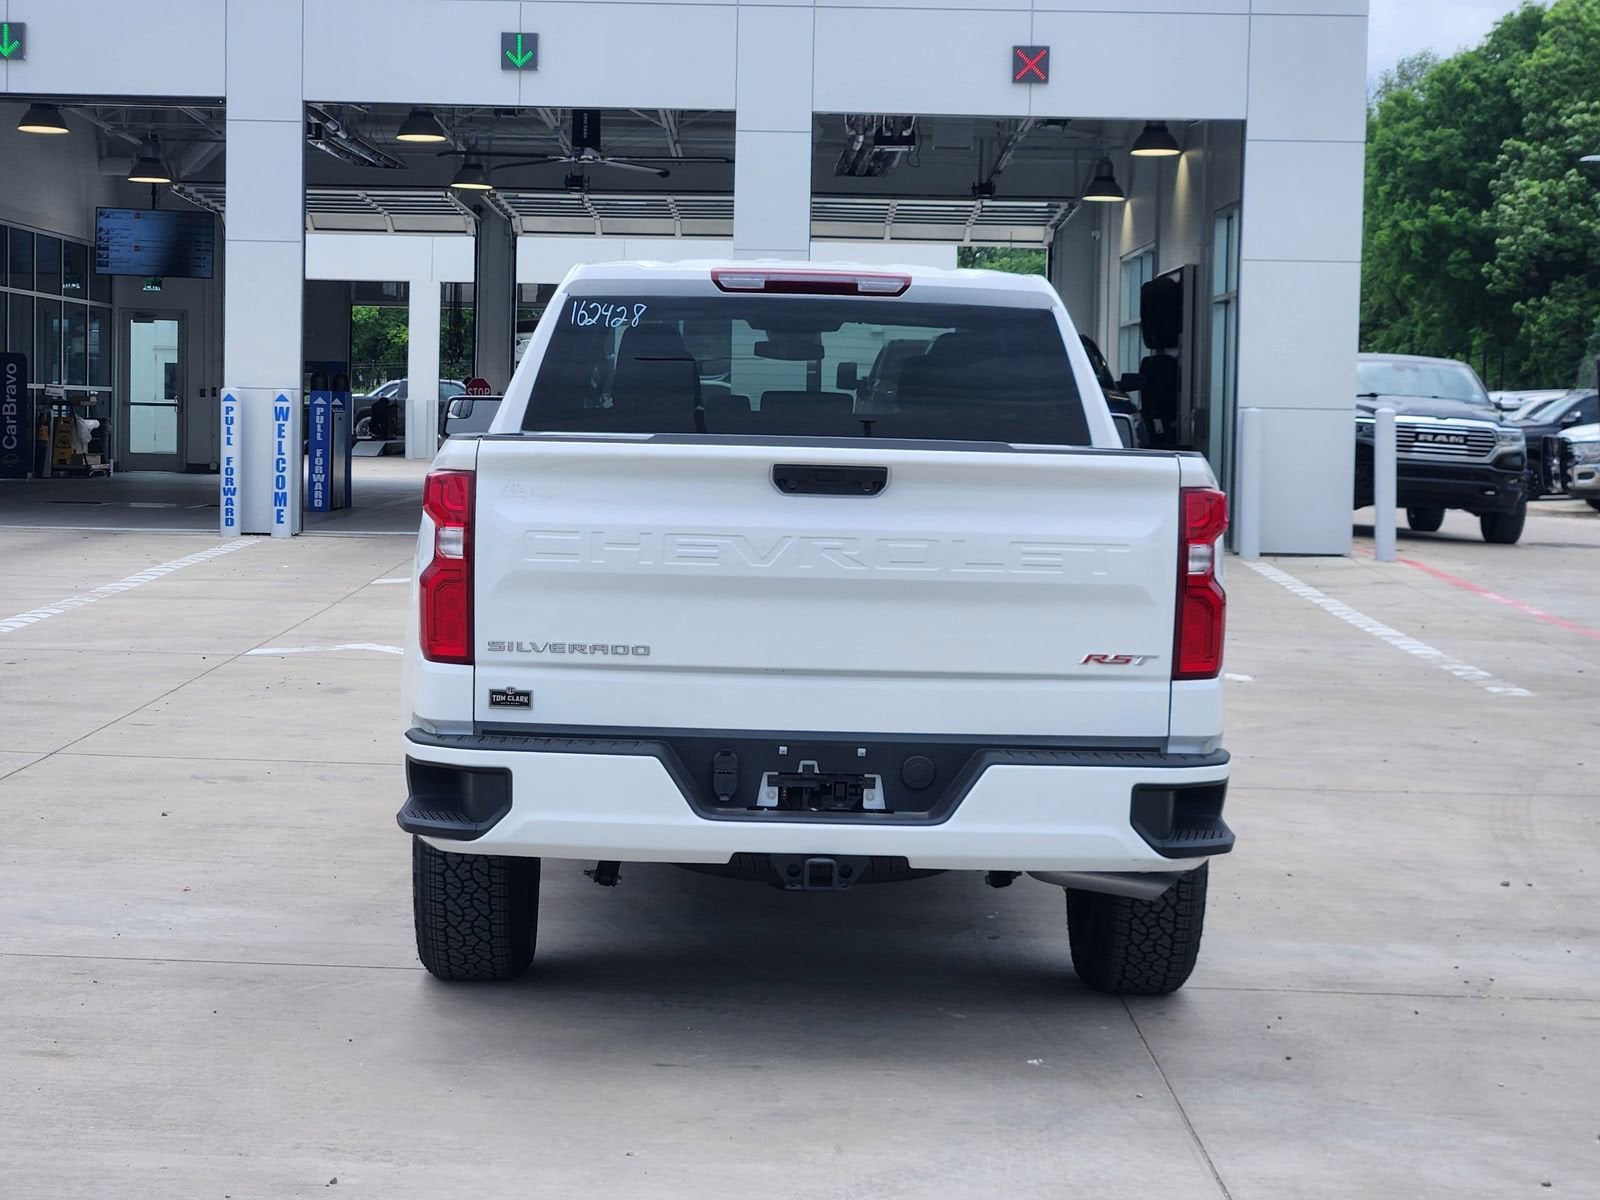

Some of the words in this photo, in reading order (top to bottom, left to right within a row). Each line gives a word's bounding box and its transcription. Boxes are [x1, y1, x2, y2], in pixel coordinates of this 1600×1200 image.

[571, 300, 648, 328] 162428
[2, 363, 17, 450] CarBravo
[467, 387, 491, 397] STOP
[225, 406, 234, 446] PULL
[315, 407, 324, 441] PULL
[1417, 433, 1465, 444] RAM
[274, 406, 290, 524] WELCOME
[312, 449, 326, 508] FORWARD
[222, 456, 237, 527] FORWARD
[522, 529, 1131, 575] CHEVROLET
[487, 640, 651, 656] SILVERADO
[1078, 653, 1159, 666] RST
[492, 694, 506, 702] TOM
[507, 695, 529, 704] CLARK
